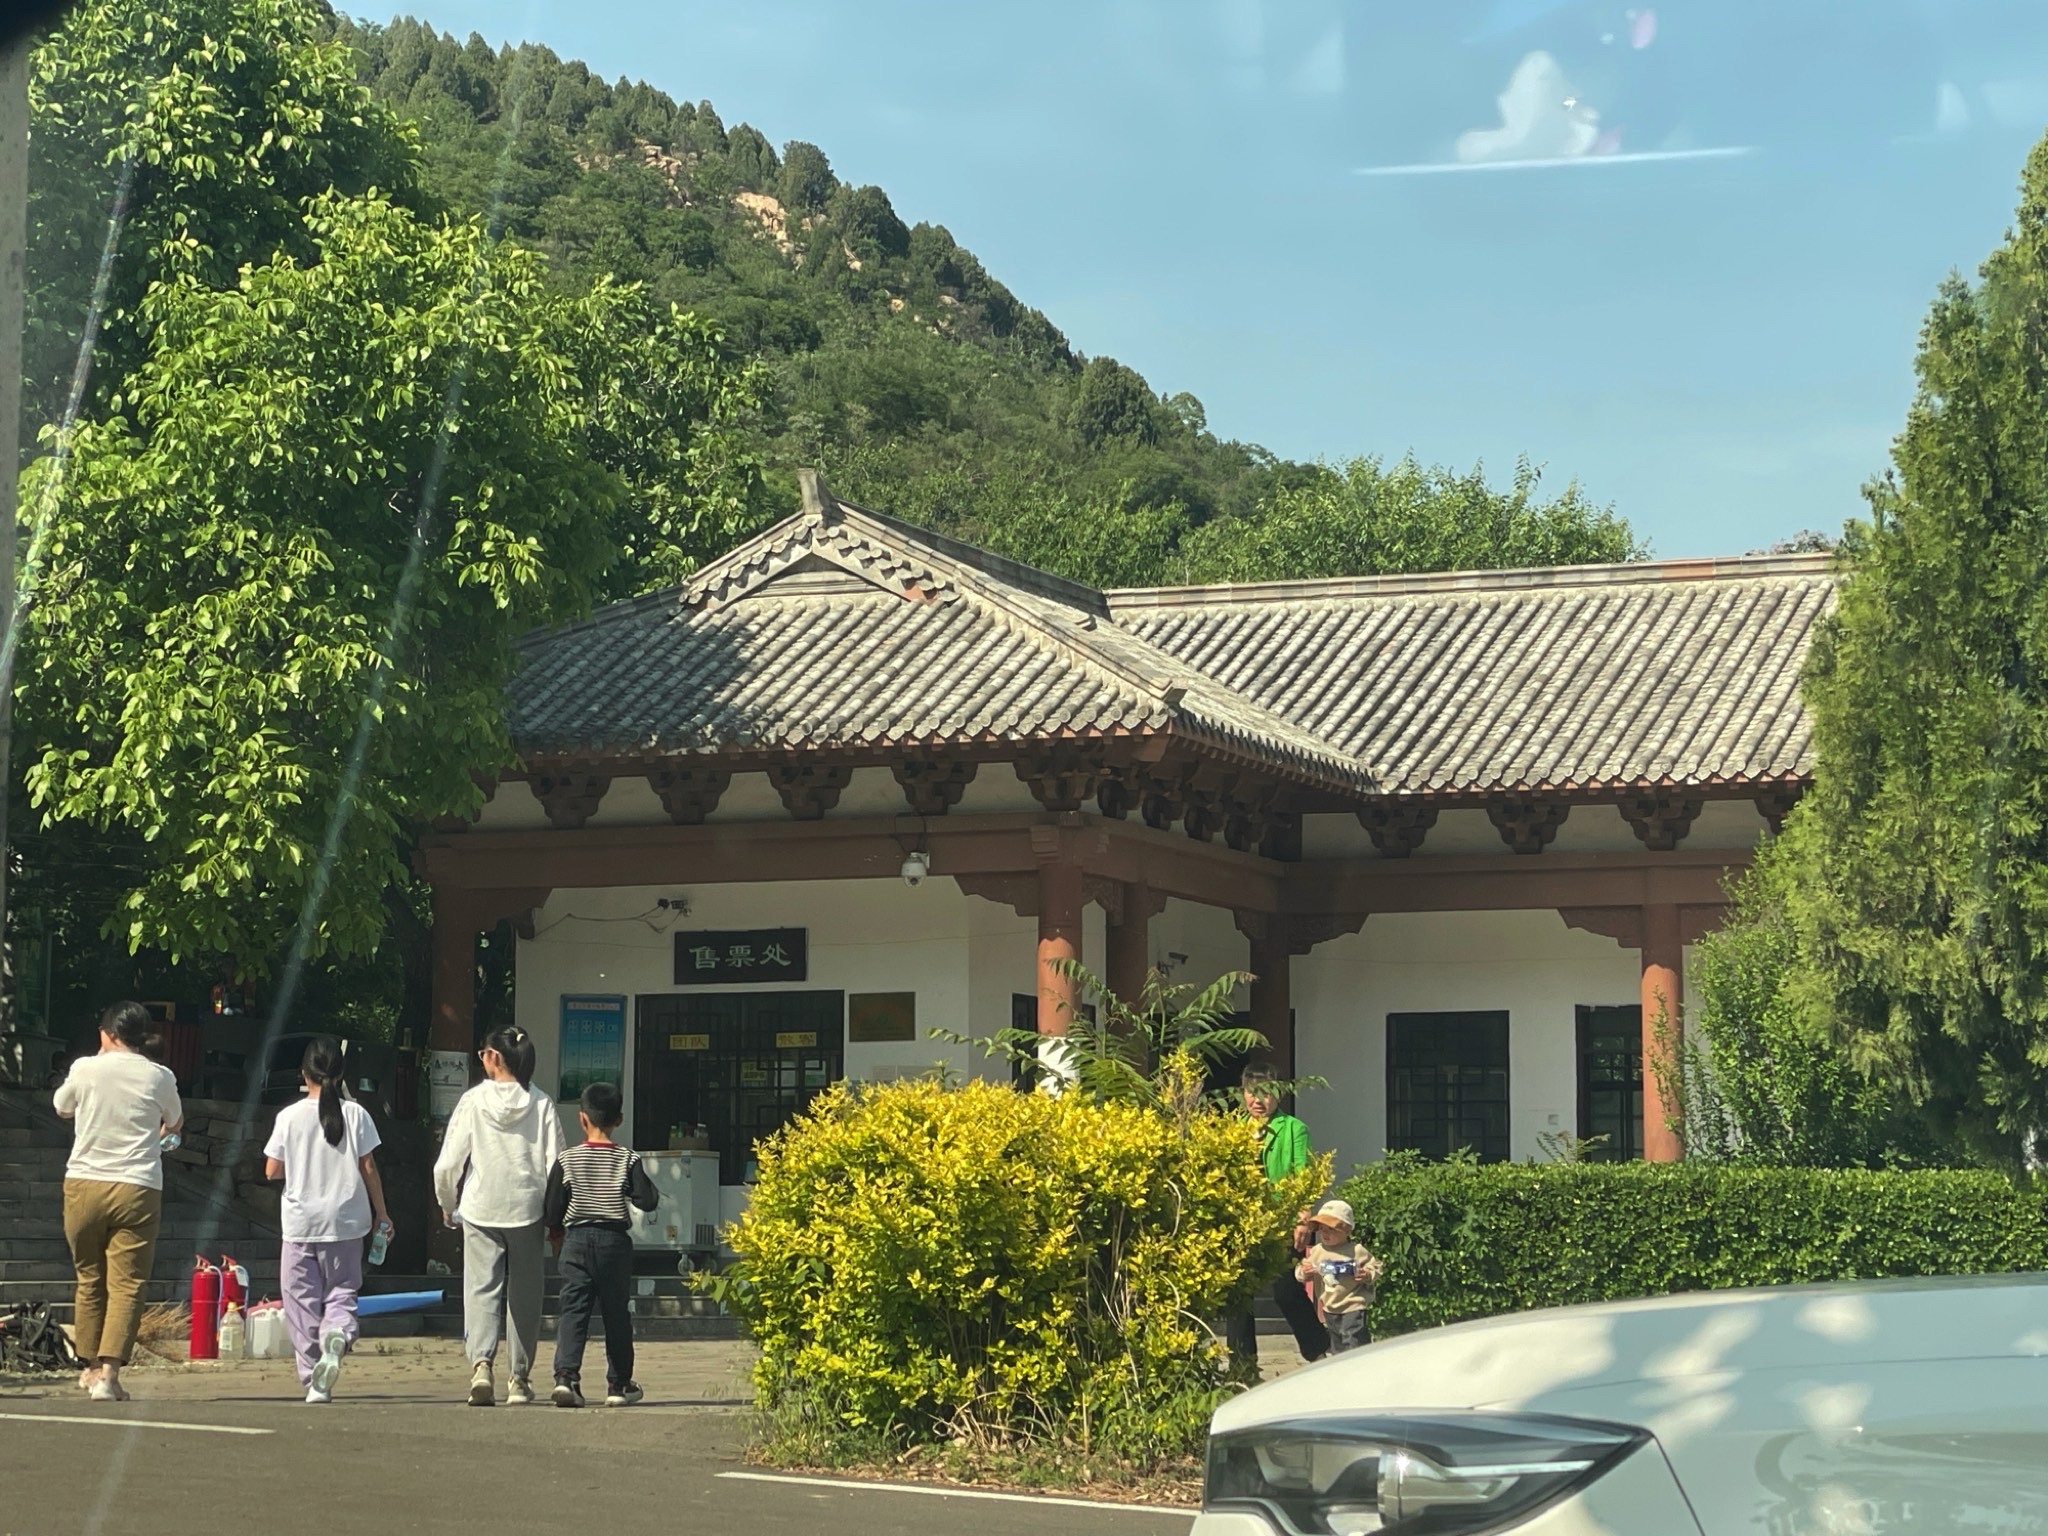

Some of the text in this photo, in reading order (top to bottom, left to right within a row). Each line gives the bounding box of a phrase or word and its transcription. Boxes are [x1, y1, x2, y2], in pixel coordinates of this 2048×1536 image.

[689, 942, 791, 970] 售票处
[672, 1036, 707, 1048] 团队
